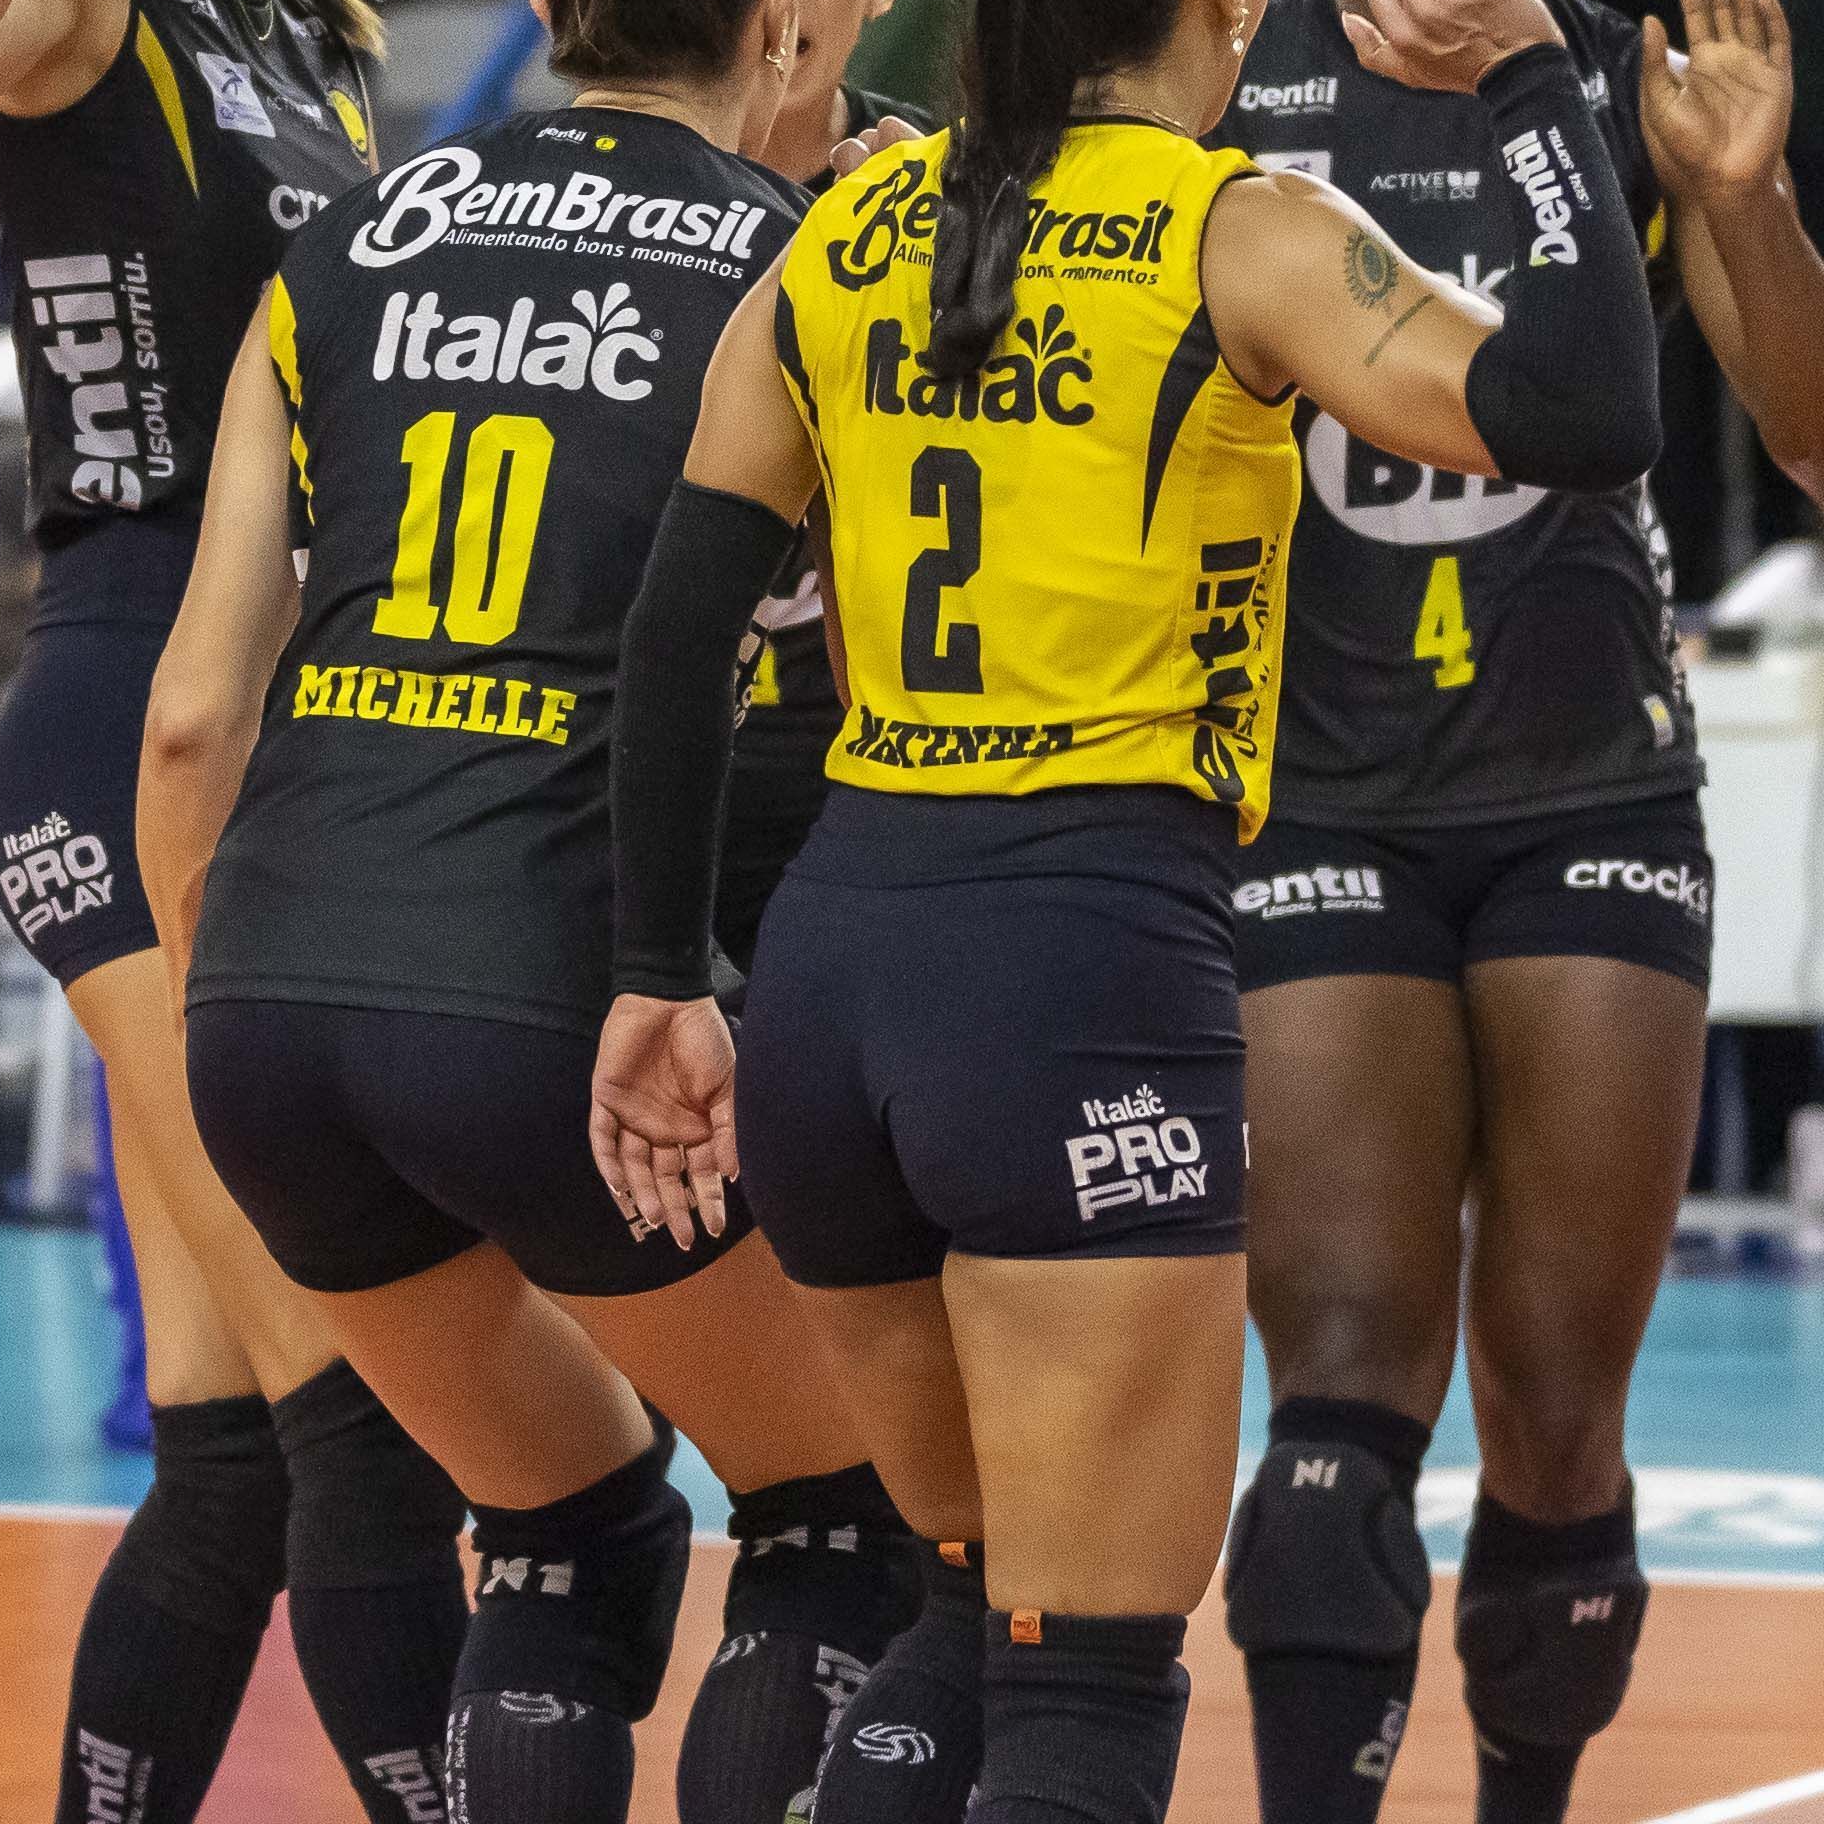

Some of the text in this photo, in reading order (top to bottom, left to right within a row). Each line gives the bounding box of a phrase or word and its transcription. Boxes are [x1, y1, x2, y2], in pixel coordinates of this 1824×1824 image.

[1236, 76, 1338, 112] Dentil
[348, 145, 767, 269] BemBrasil
[1502, 128, 1579, 267] Dentil
[439, 227, 745, 281] Alimentando bons momentos
[1060, 265, 1160, 286] momentos
[120, 251, 160, 371] sorriu.
[372, 283, 662, 402] Italac
[371, 411, 556, 646] 10
[902, 445, 984, 694] 2
[1413, 556, 1475, 689] 4
[292, 663, 577, 746] MICHELLE
[2, 810, 72, 860] Italac
[17, 873, 115, 945] PLAY
[1082, 1083, 1166, 1127] Italac
[1065, 1116, 1201, 1188] PRO
[1076, 1164, 1209, 1222] PLAY
